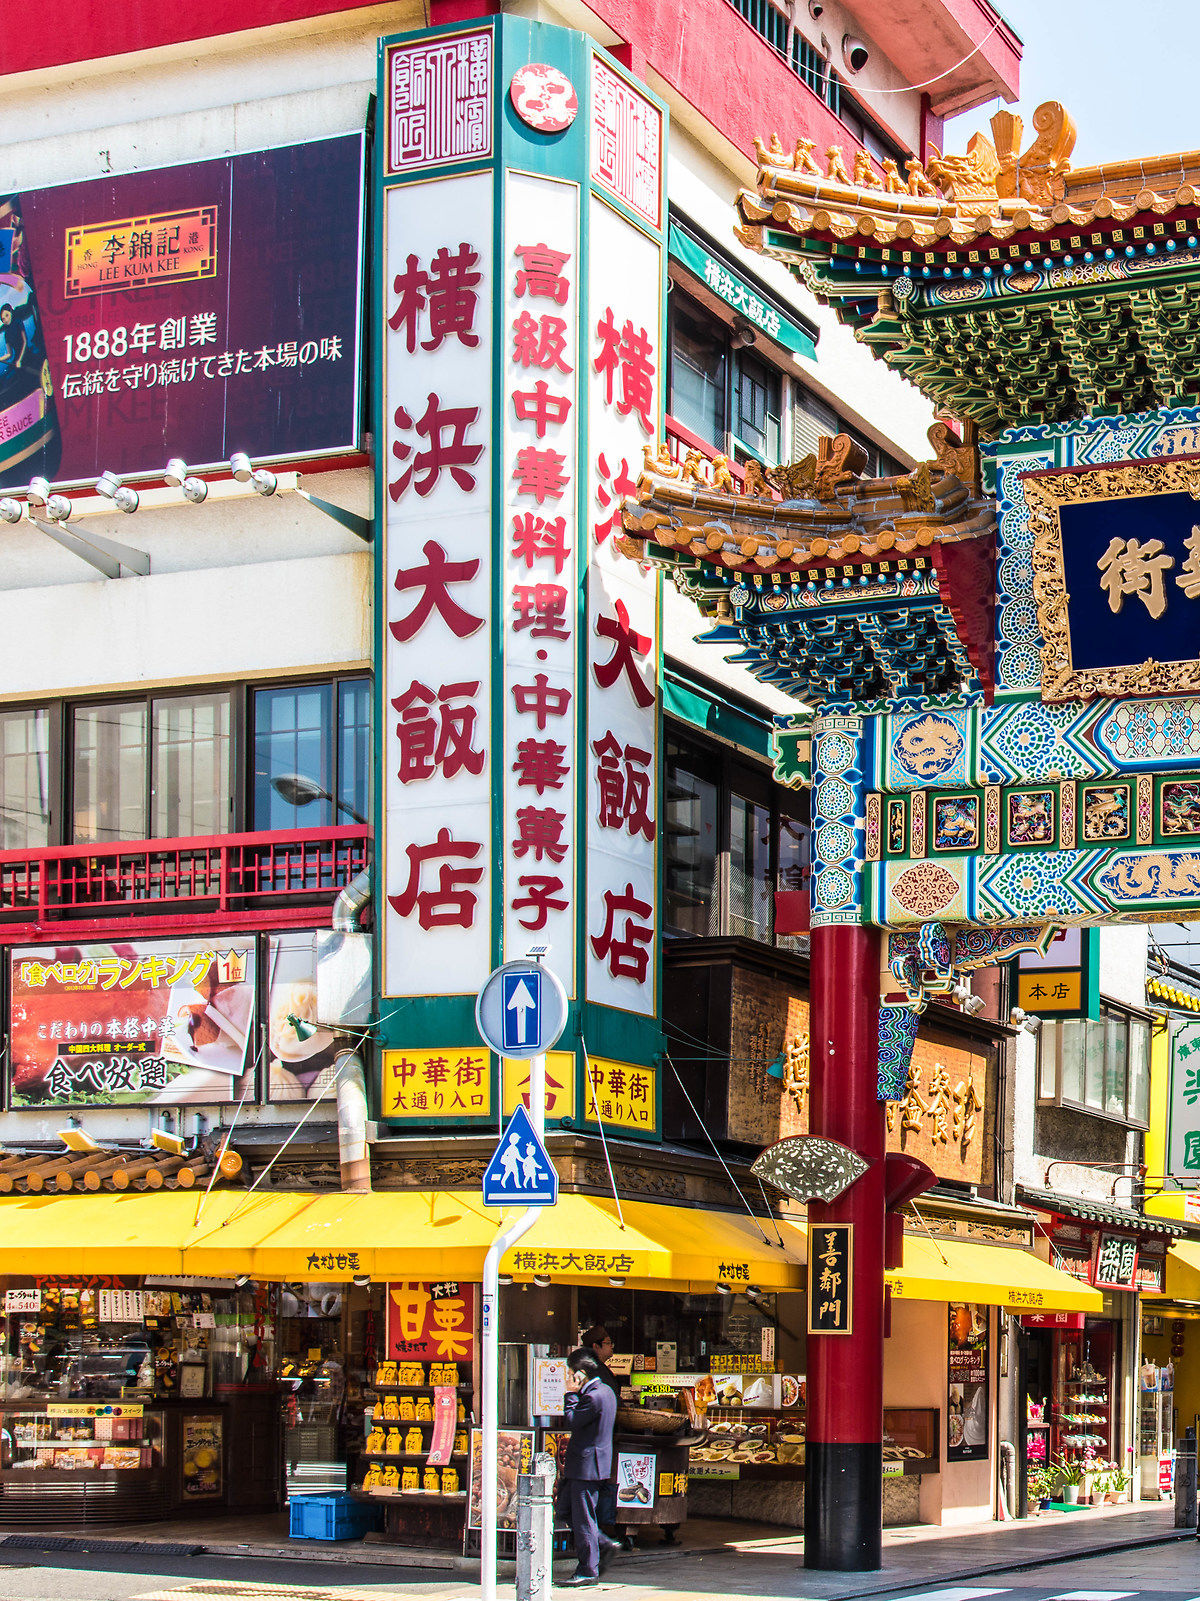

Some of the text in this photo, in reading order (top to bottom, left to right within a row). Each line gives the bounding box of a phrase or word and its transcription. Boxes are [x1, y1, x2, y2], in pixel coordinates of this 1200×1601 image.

[101, 225, 180, 264] 李錦記
[99, 257, 179, 281] LEE KUM KEE
[704, 258, 782, 339] 横浜大飯店
[62, 312, 218, 364] 1888年創業
[61, 335, 343, 399] 伝統を守り続けてきた本場の味
[6, 413, 33, 437] SAUCE
[387, 243, 486, 931] 横浜大飯店
[511, 243, 573, 931] 高級中華料理・中華菓子
[222, 961, 242, 981] 1位
[1029, 983, 1070, 1000] 本店
[37, 1016, 176, 1039] こだわりの本格中華
[45, 1056, 167, 1096] 食べ放題
[391, 1056, 486, 1088] 中華街
[588, 1063, 650, 1103] 中華街
[391, 1090, 485, 1111] 大通り入口
[588, 1099, 649, 1123] 大通り入口
[306, 1252, 360, 1271] 大粒甘栗
[514, 1251, 634, 1273] 横浜大飯店
[717, 1262, 749, 1282] 大粒甘栗
[432, 1281, 458, 1298] 大粒
[1008, 1291, 1044, 1306] 横浜大飯店
